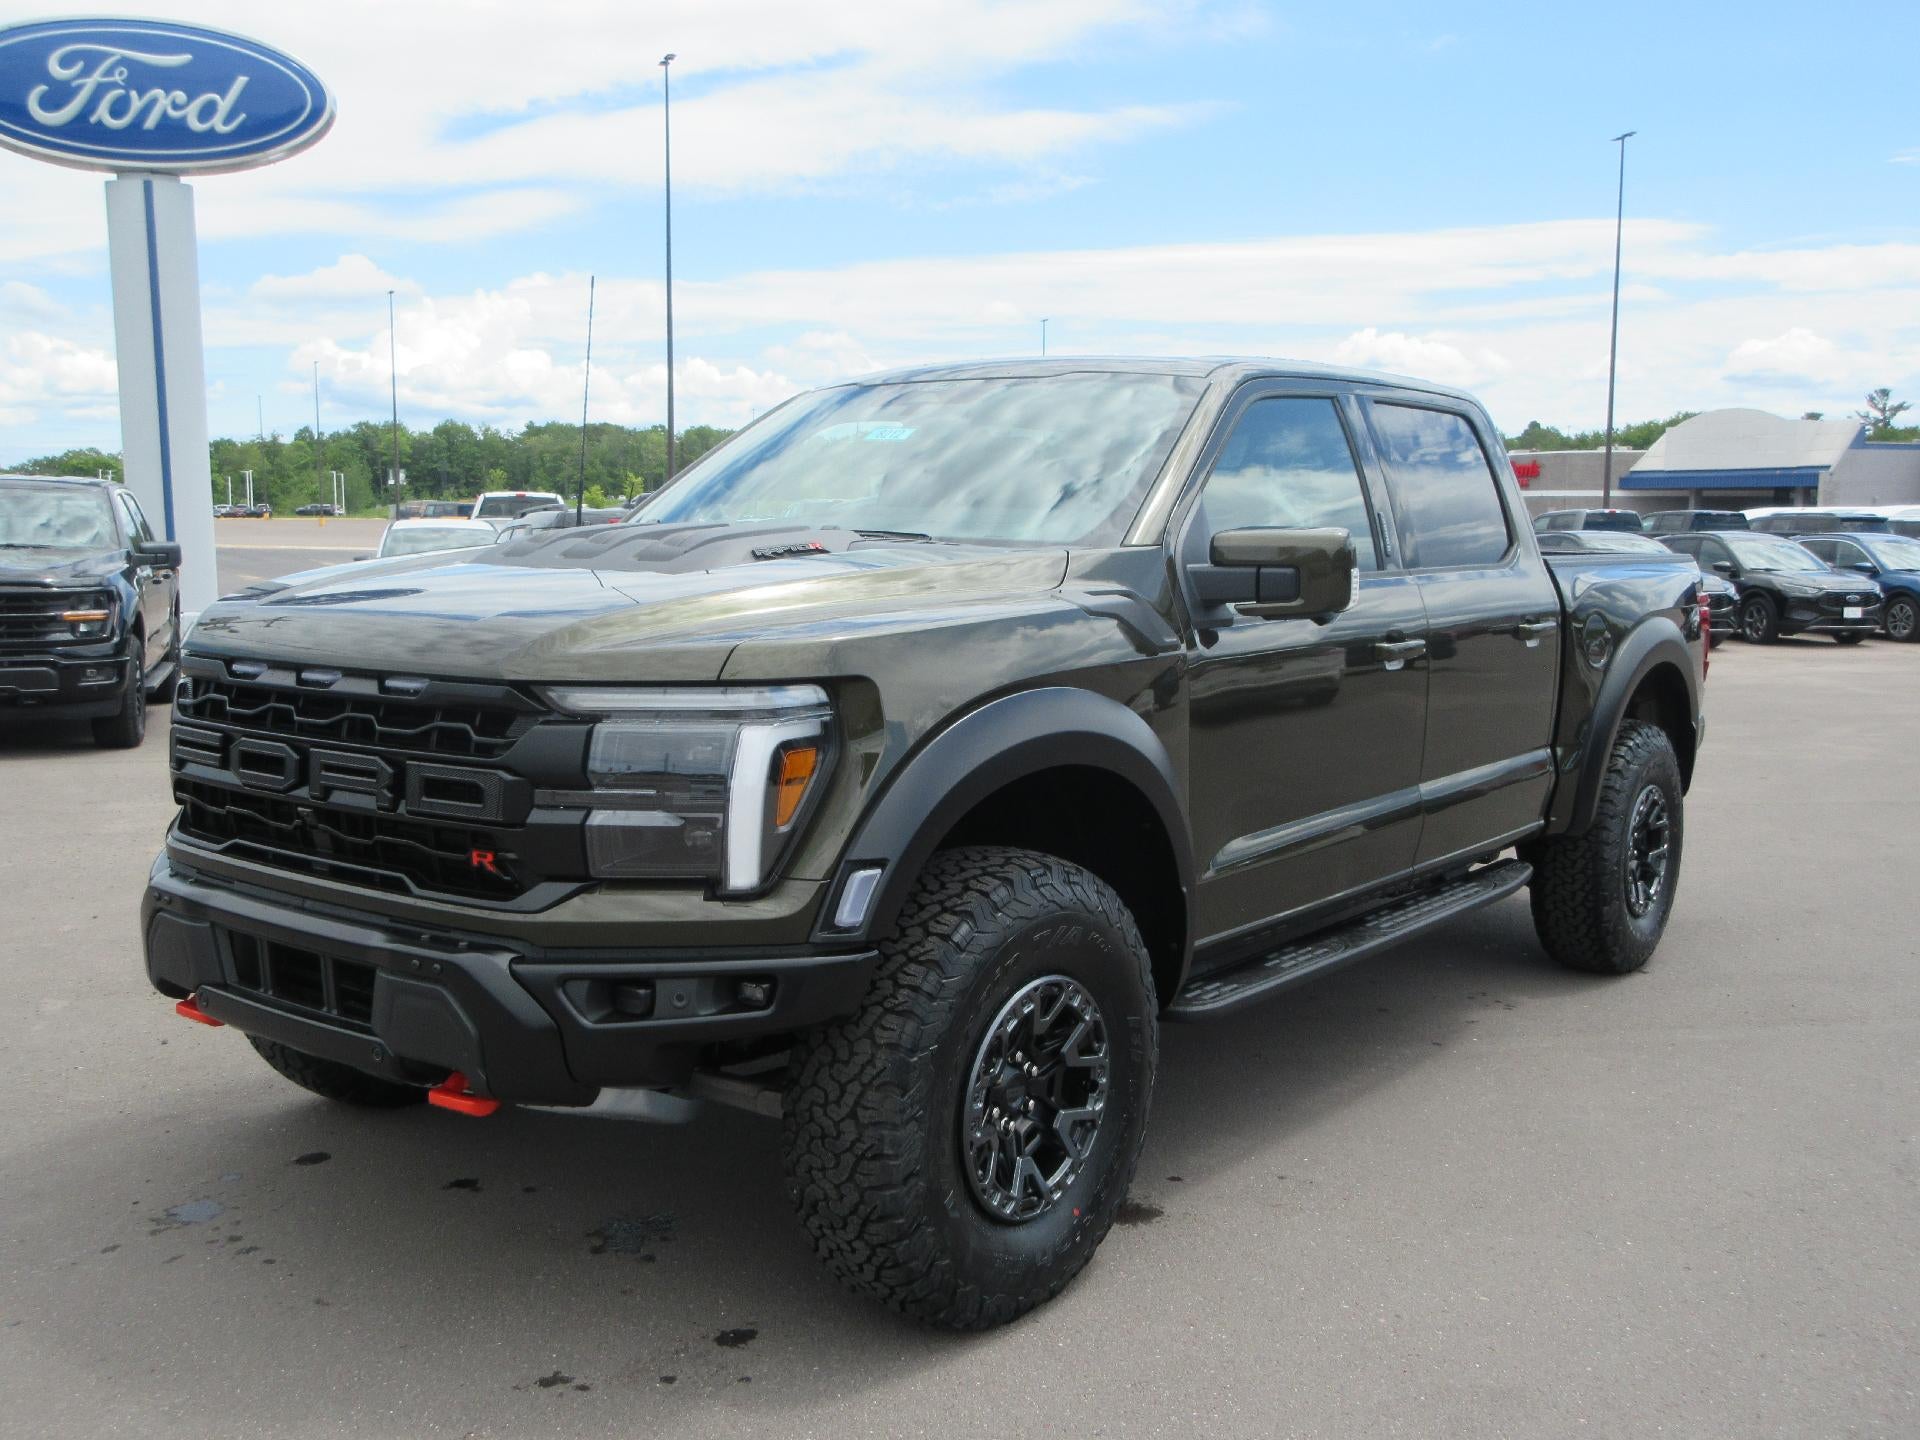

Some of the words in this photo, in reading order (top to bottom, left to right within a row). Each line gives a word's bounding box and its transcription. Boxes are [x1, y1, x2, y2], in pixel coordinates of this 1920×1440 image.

[27, 43, 250, 134] Ford
[170, 724, 522, 826] FORD
[471, 849, 497, 873] R
